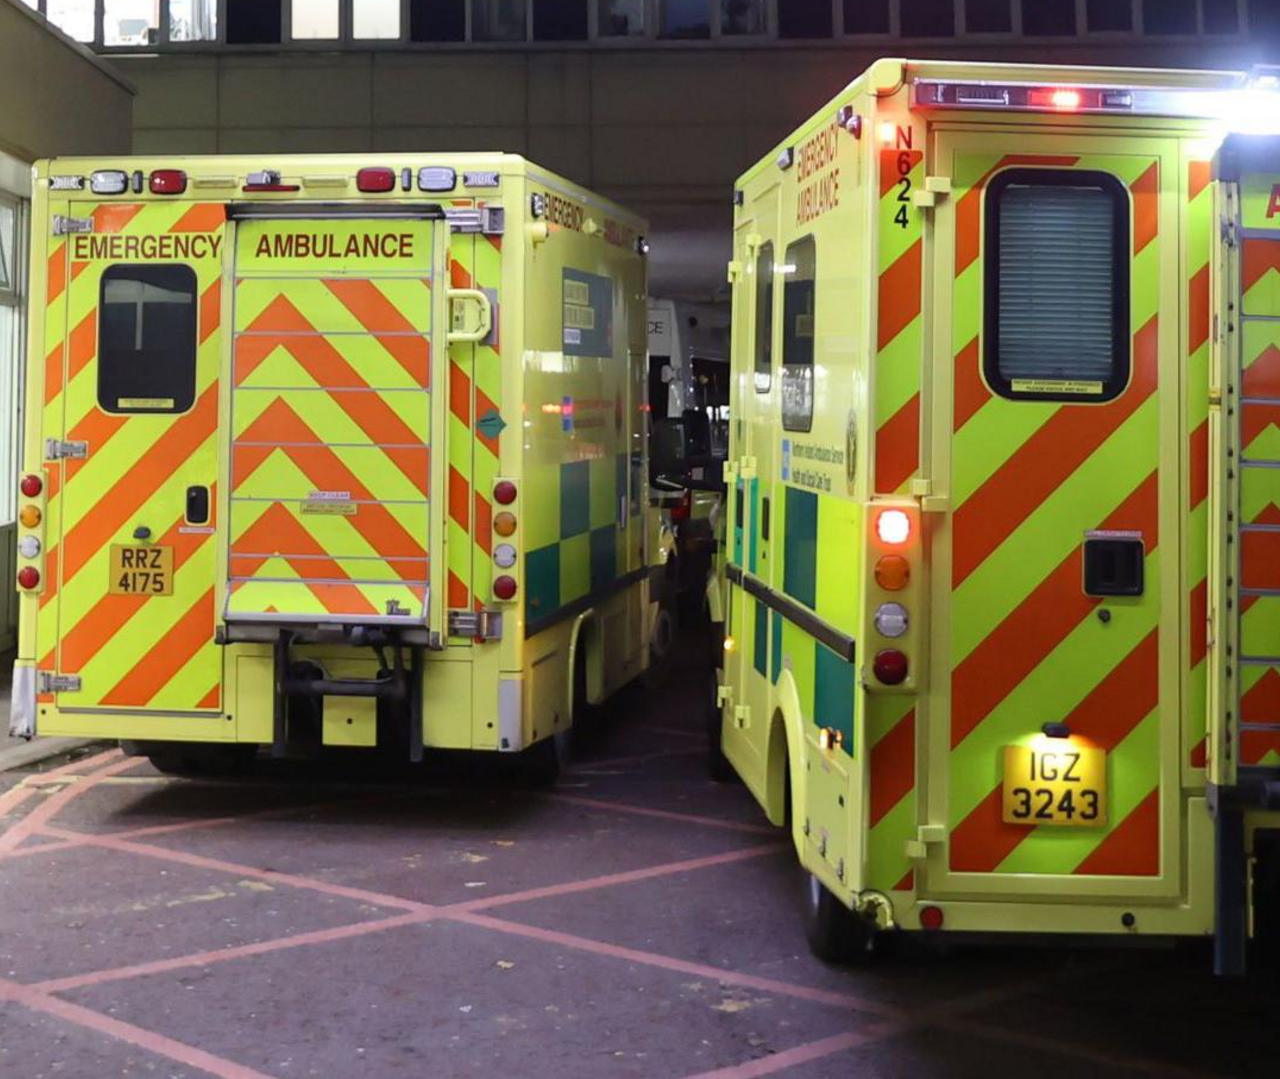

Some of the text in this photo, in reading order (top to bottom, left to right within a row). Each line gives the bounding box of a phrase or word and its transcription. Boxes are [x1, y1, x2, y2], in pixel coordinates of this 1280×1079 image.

[796, 168, 839, 227] AMBULANCE
[74, 233, 414, 259] EMERGENCY AMBULANCE
[648, 321, 664, 334] CE
[121, 548, 162, 568] RRZ
[118, 573, 164, 592] 4175
[1030, 752, 1080, 782] IGZ
[1012, 787, 1098, 820] 3243
